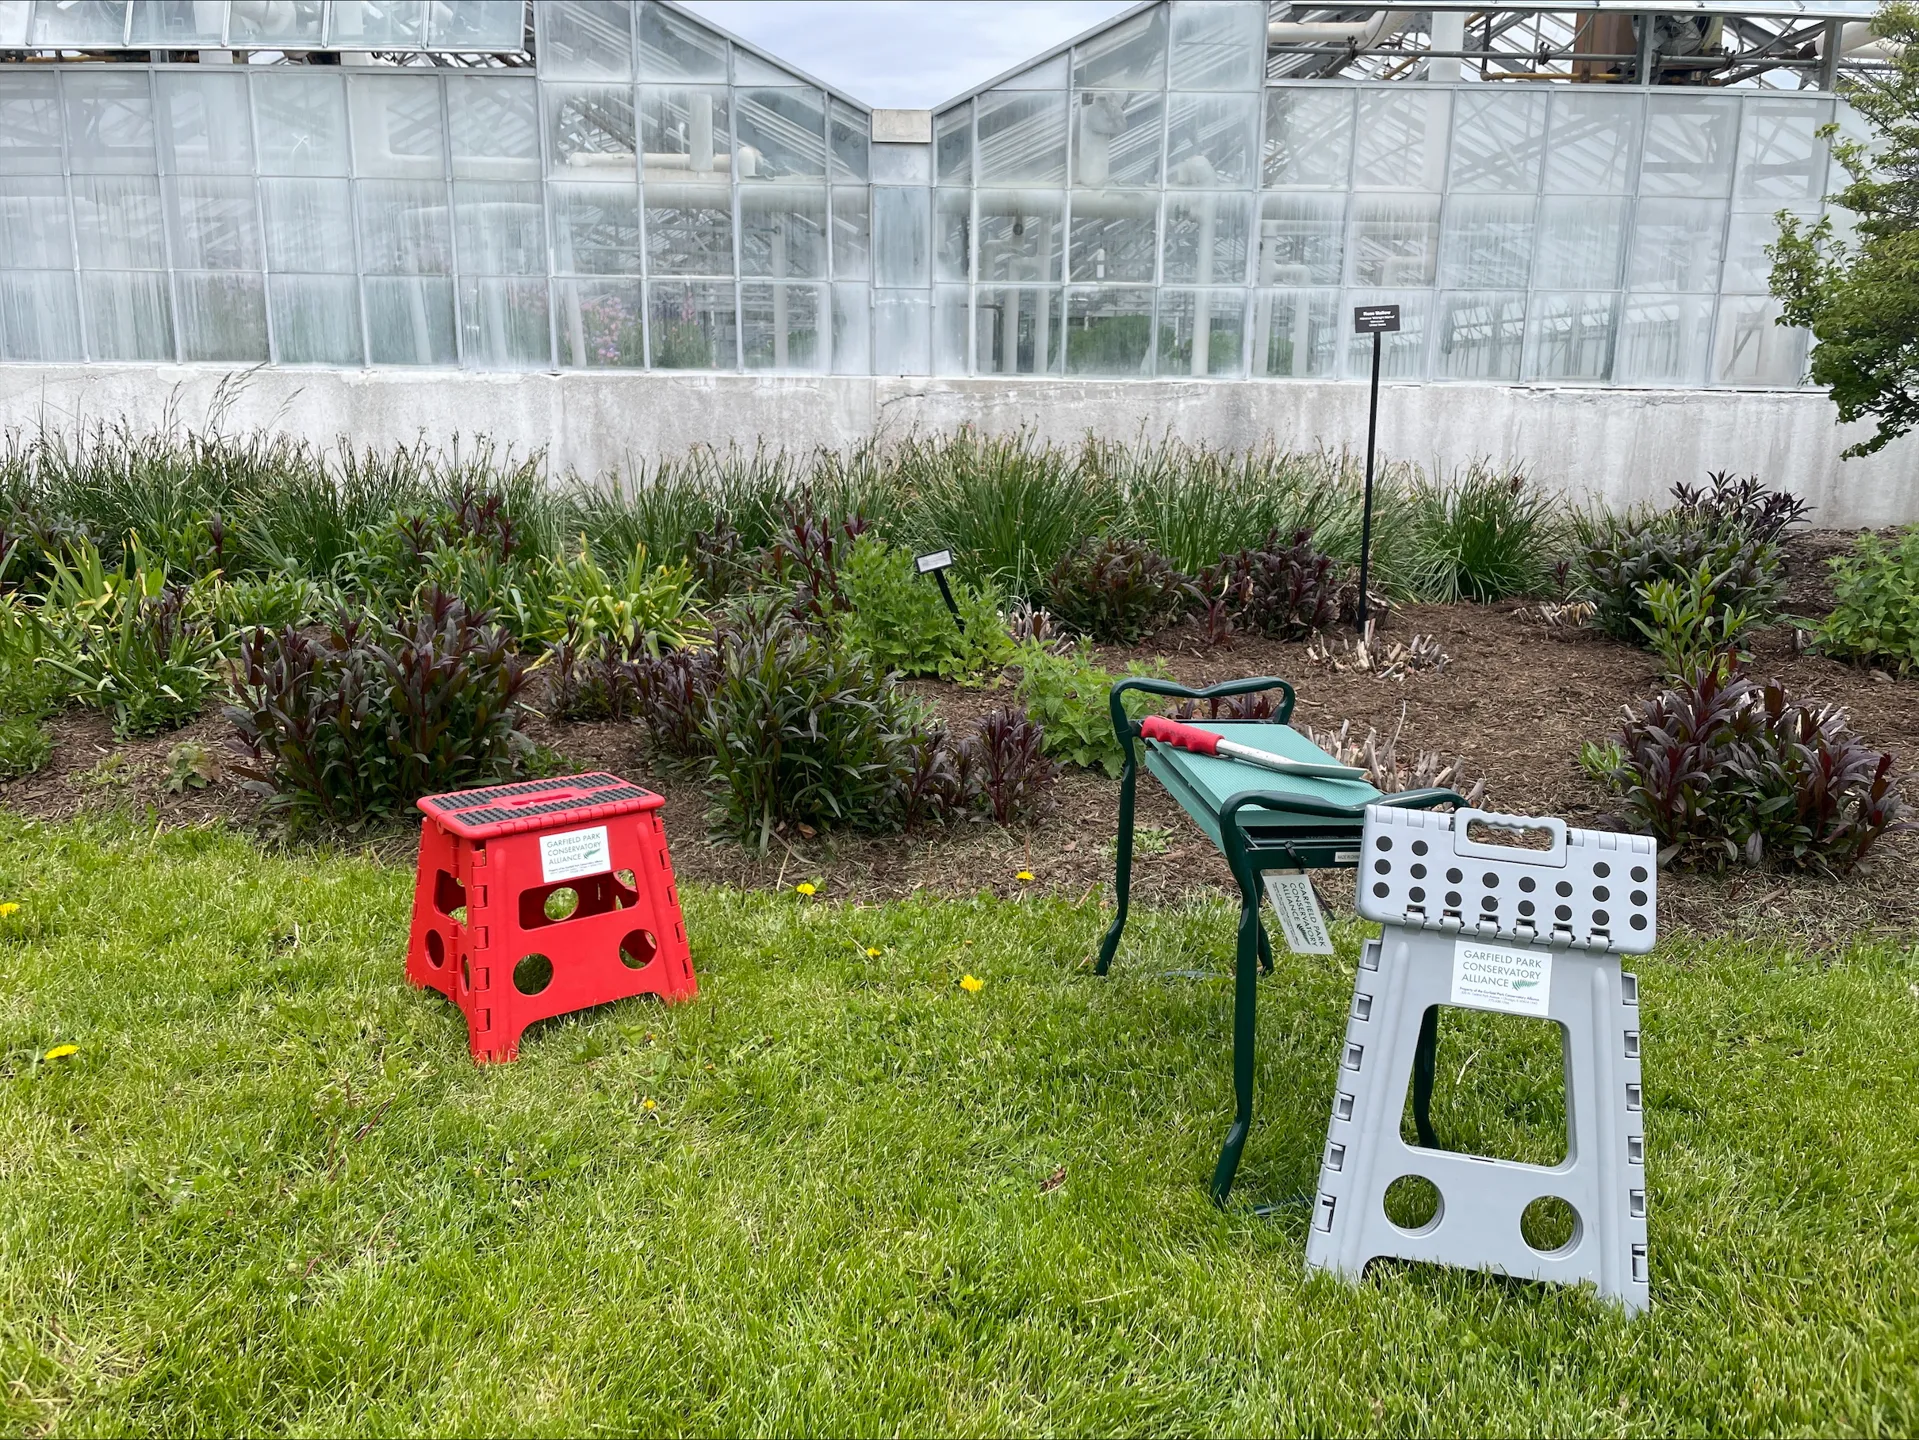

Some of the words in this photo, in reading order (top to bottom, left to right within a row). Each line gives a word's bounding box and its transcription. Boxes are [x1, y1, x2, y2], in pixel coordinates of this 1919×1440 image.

[547, 836, 581, 848] GARFIELD
[583, 833, 601, 842] PARK
[547, 841, 602, 857] CONSERVATORY
[548, 853, 581, 865] ALLIANCE
[1281, 882, 1300, 922] ALLIANCE
[1289, 882, 1318, 947] CONSERVATORY
[1298, 882, 1317, 923] GARFIELD
[1313, 925, 1327, 947] PARK
[1463, 949, 1513, 964] GARFIELD
[1516, 957, 1542, 968] PARK
[1461, 973, 1509, 987] ALLIANCE
[1462, 961, 1541, 980] CONSERVATORY
